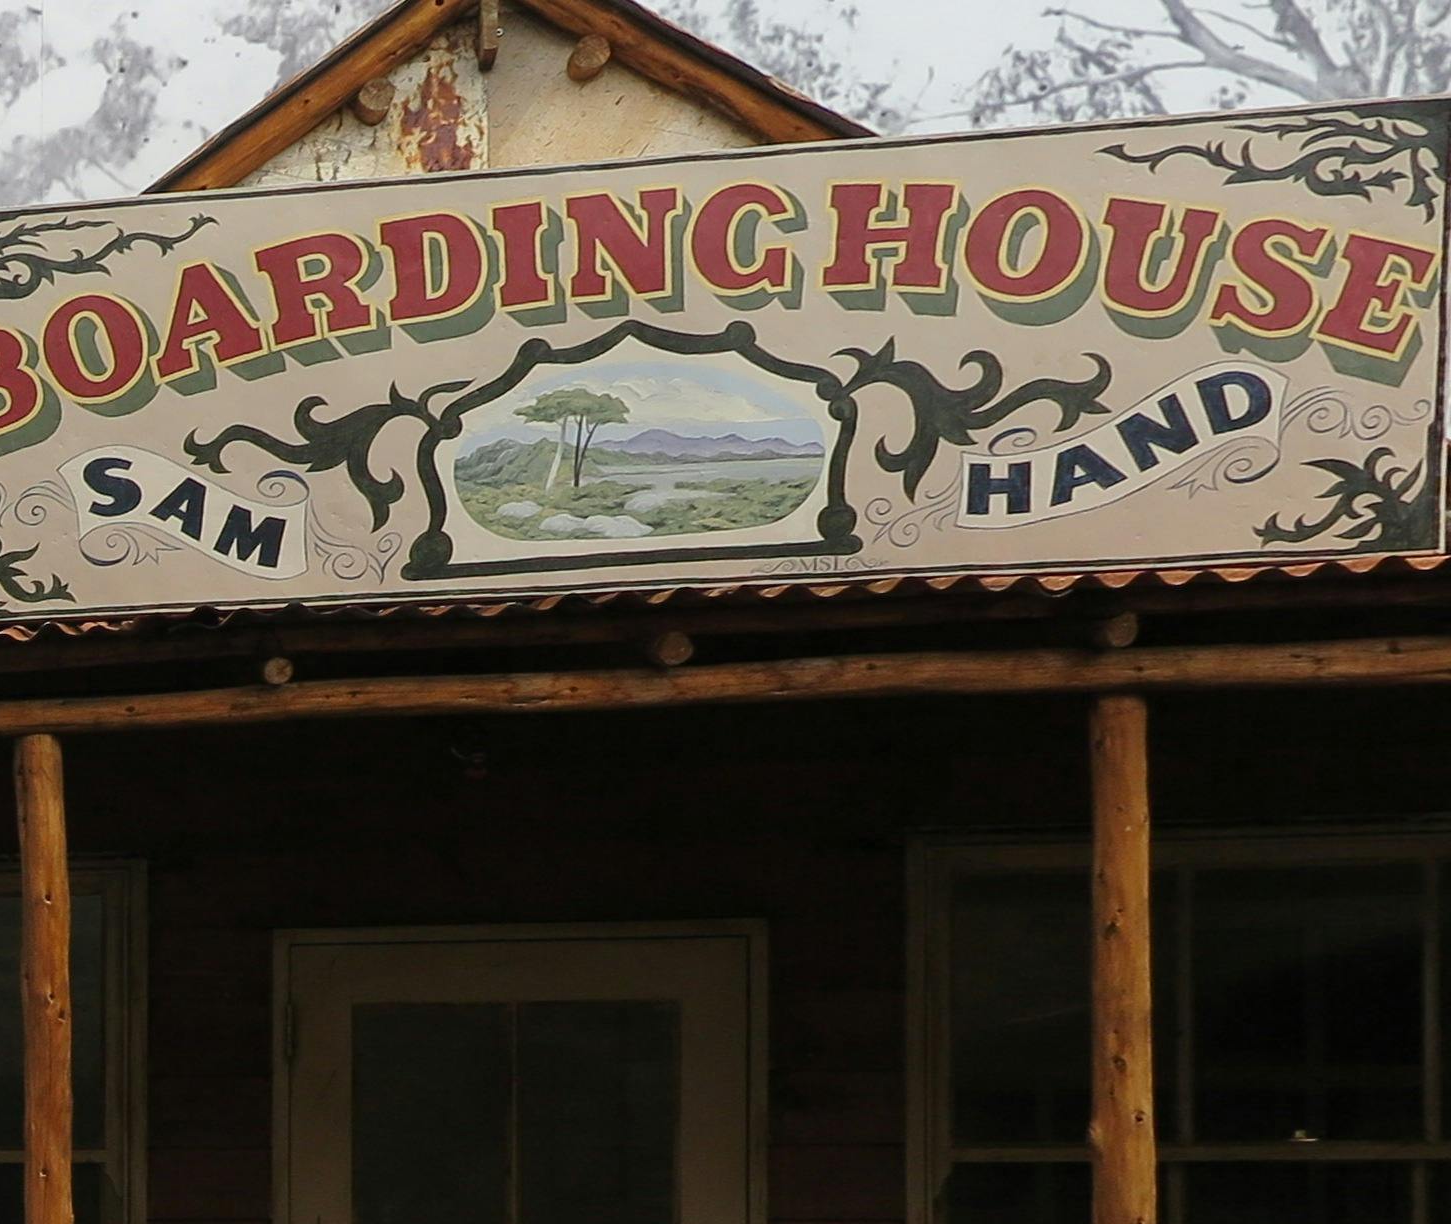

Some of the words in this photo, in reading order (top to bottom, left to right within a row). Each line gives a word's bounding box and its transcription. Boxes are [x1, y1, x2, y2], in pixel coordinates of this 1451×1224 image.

[818, 178, 1440, 366] HOUSE
[82, 456, 288, 569] SAM
[964, 369, 1273, 516] HAND
